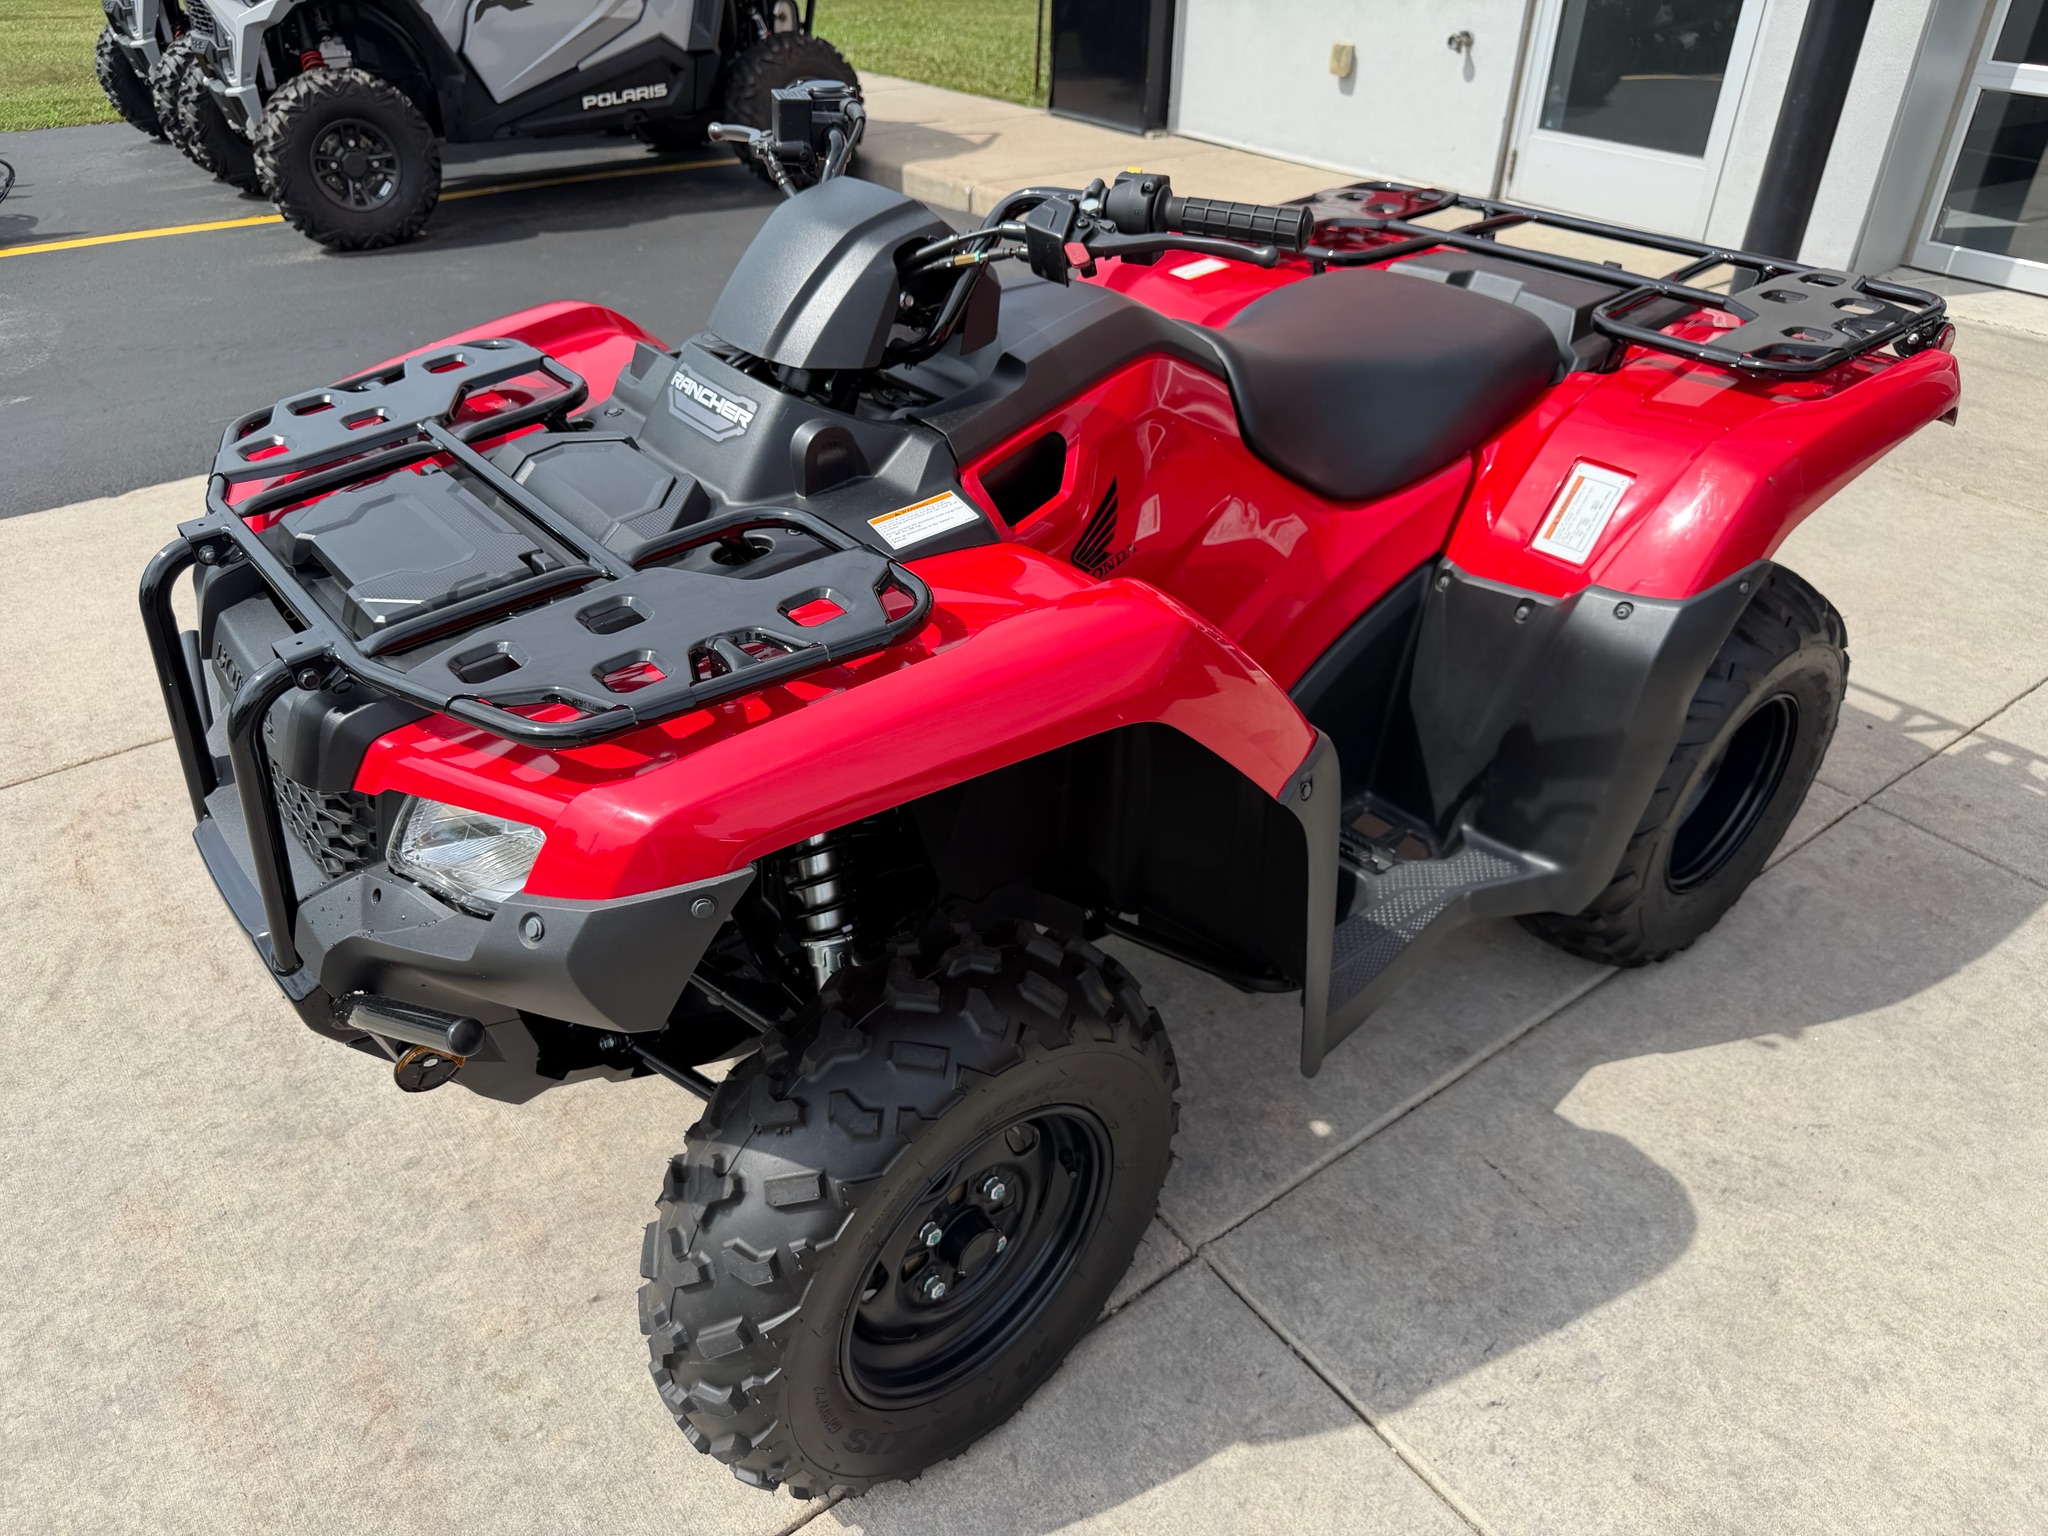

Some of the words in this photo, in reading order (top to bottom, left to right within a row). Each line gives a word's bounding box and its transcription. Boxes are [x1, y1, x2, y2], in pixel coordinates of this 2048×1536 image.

[582, 82, 668, 110] POLARIS
[670, 370, 754, 429] RANCHER
[1091, 544, 1138, 579] ONDA
